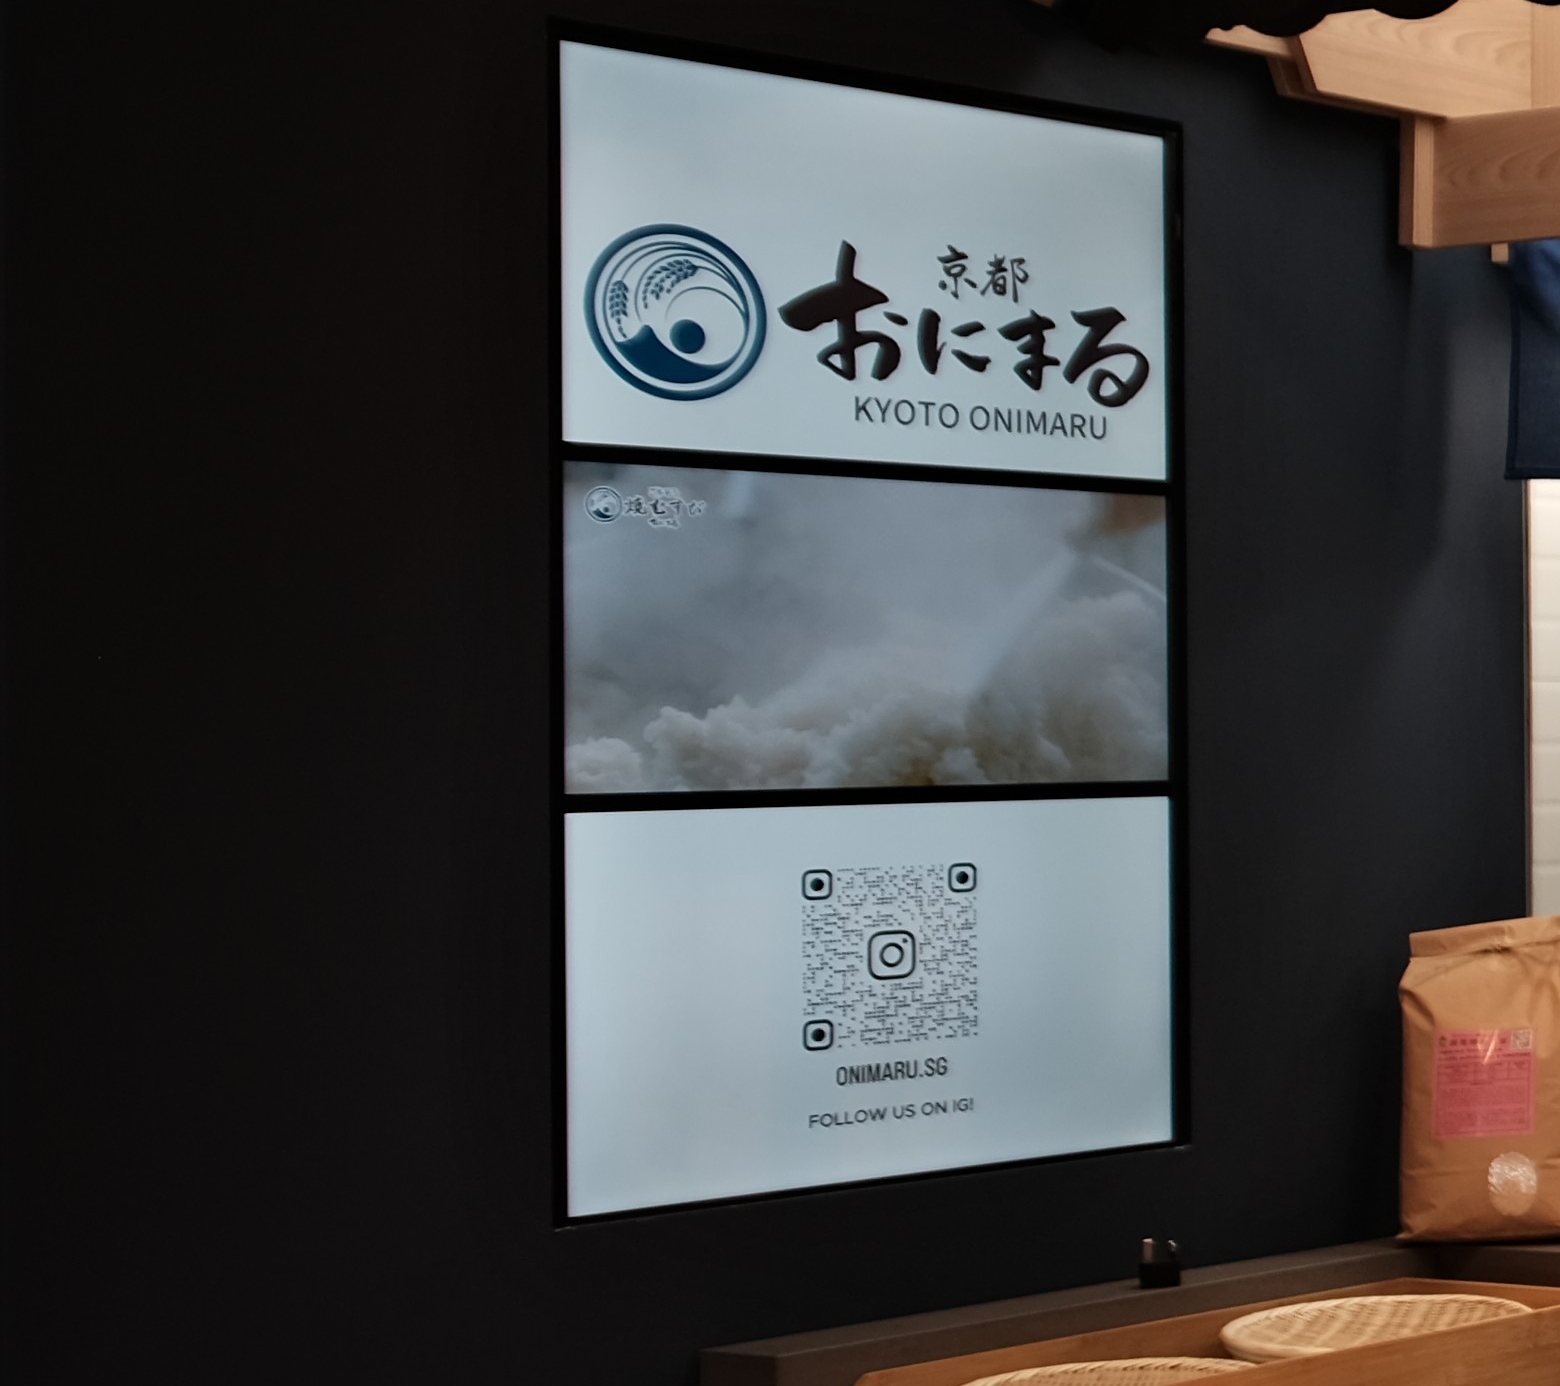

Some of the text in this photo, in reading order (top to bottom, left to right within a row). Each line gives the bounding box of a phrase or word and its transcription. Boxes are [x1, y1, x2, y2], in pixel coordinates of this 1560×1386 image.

[936, 245, 1029, 303] 京都
[778, 240, 1149, 408] おにまる
[855, 396, 1107, 440] KYOTO ONIMARU
[836, 1057, 948, 1086] ONIMARU.SG
[809, 1097, 973, 1129] FOLLOW US ON IG!
